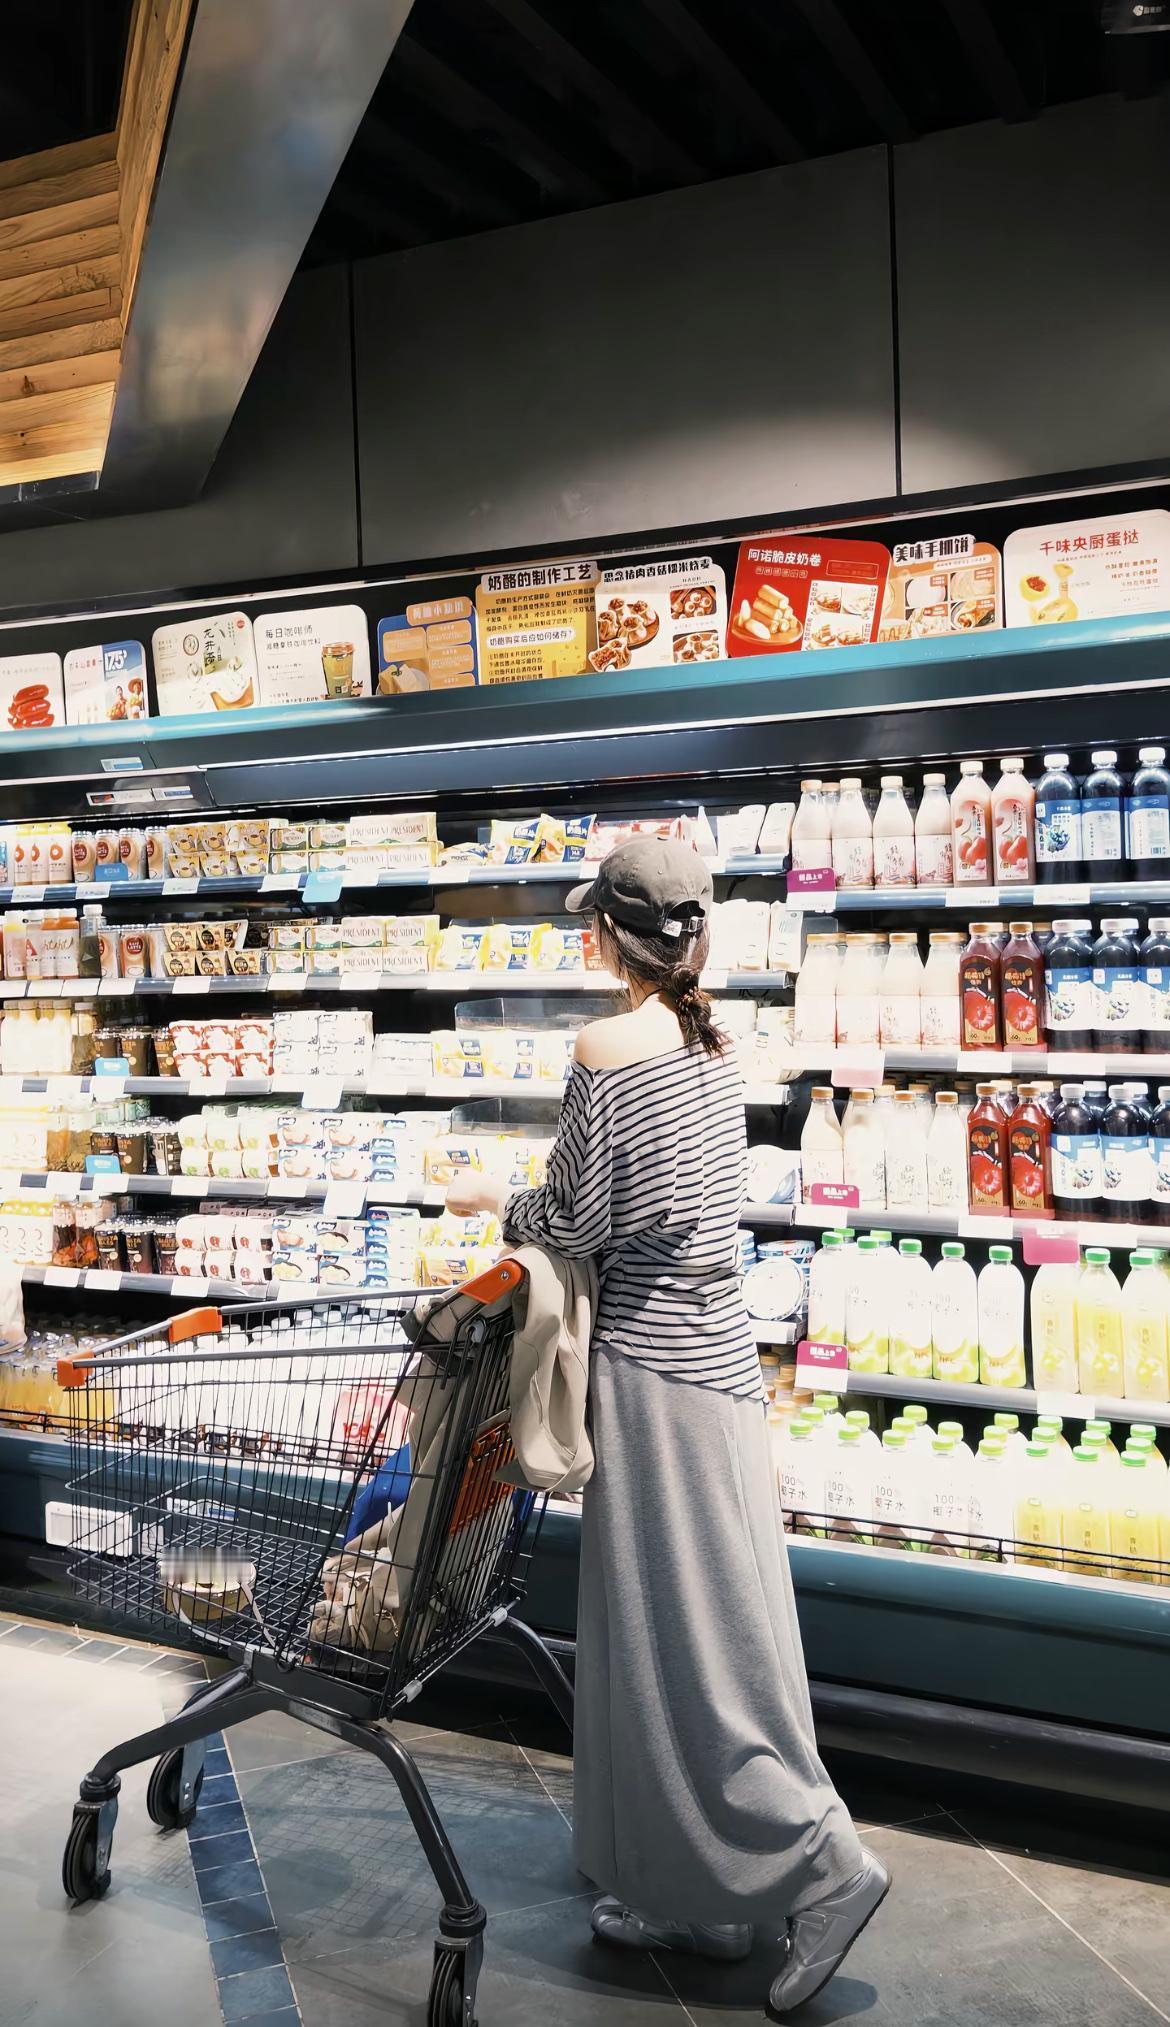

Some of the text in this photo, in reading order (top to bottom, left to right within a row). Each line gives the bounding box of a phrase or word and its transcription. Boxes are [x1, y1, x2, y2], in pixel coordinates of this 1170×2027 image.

[896, 537, 969, 562] 美味手抓饼
[1039, 529, 1140, 556] 千味央厨蛋挞
[748, 548, 822, 567] 阿诺脆皮奶卷
[488, 564, 592, 591] 奶酪的制作工艺
